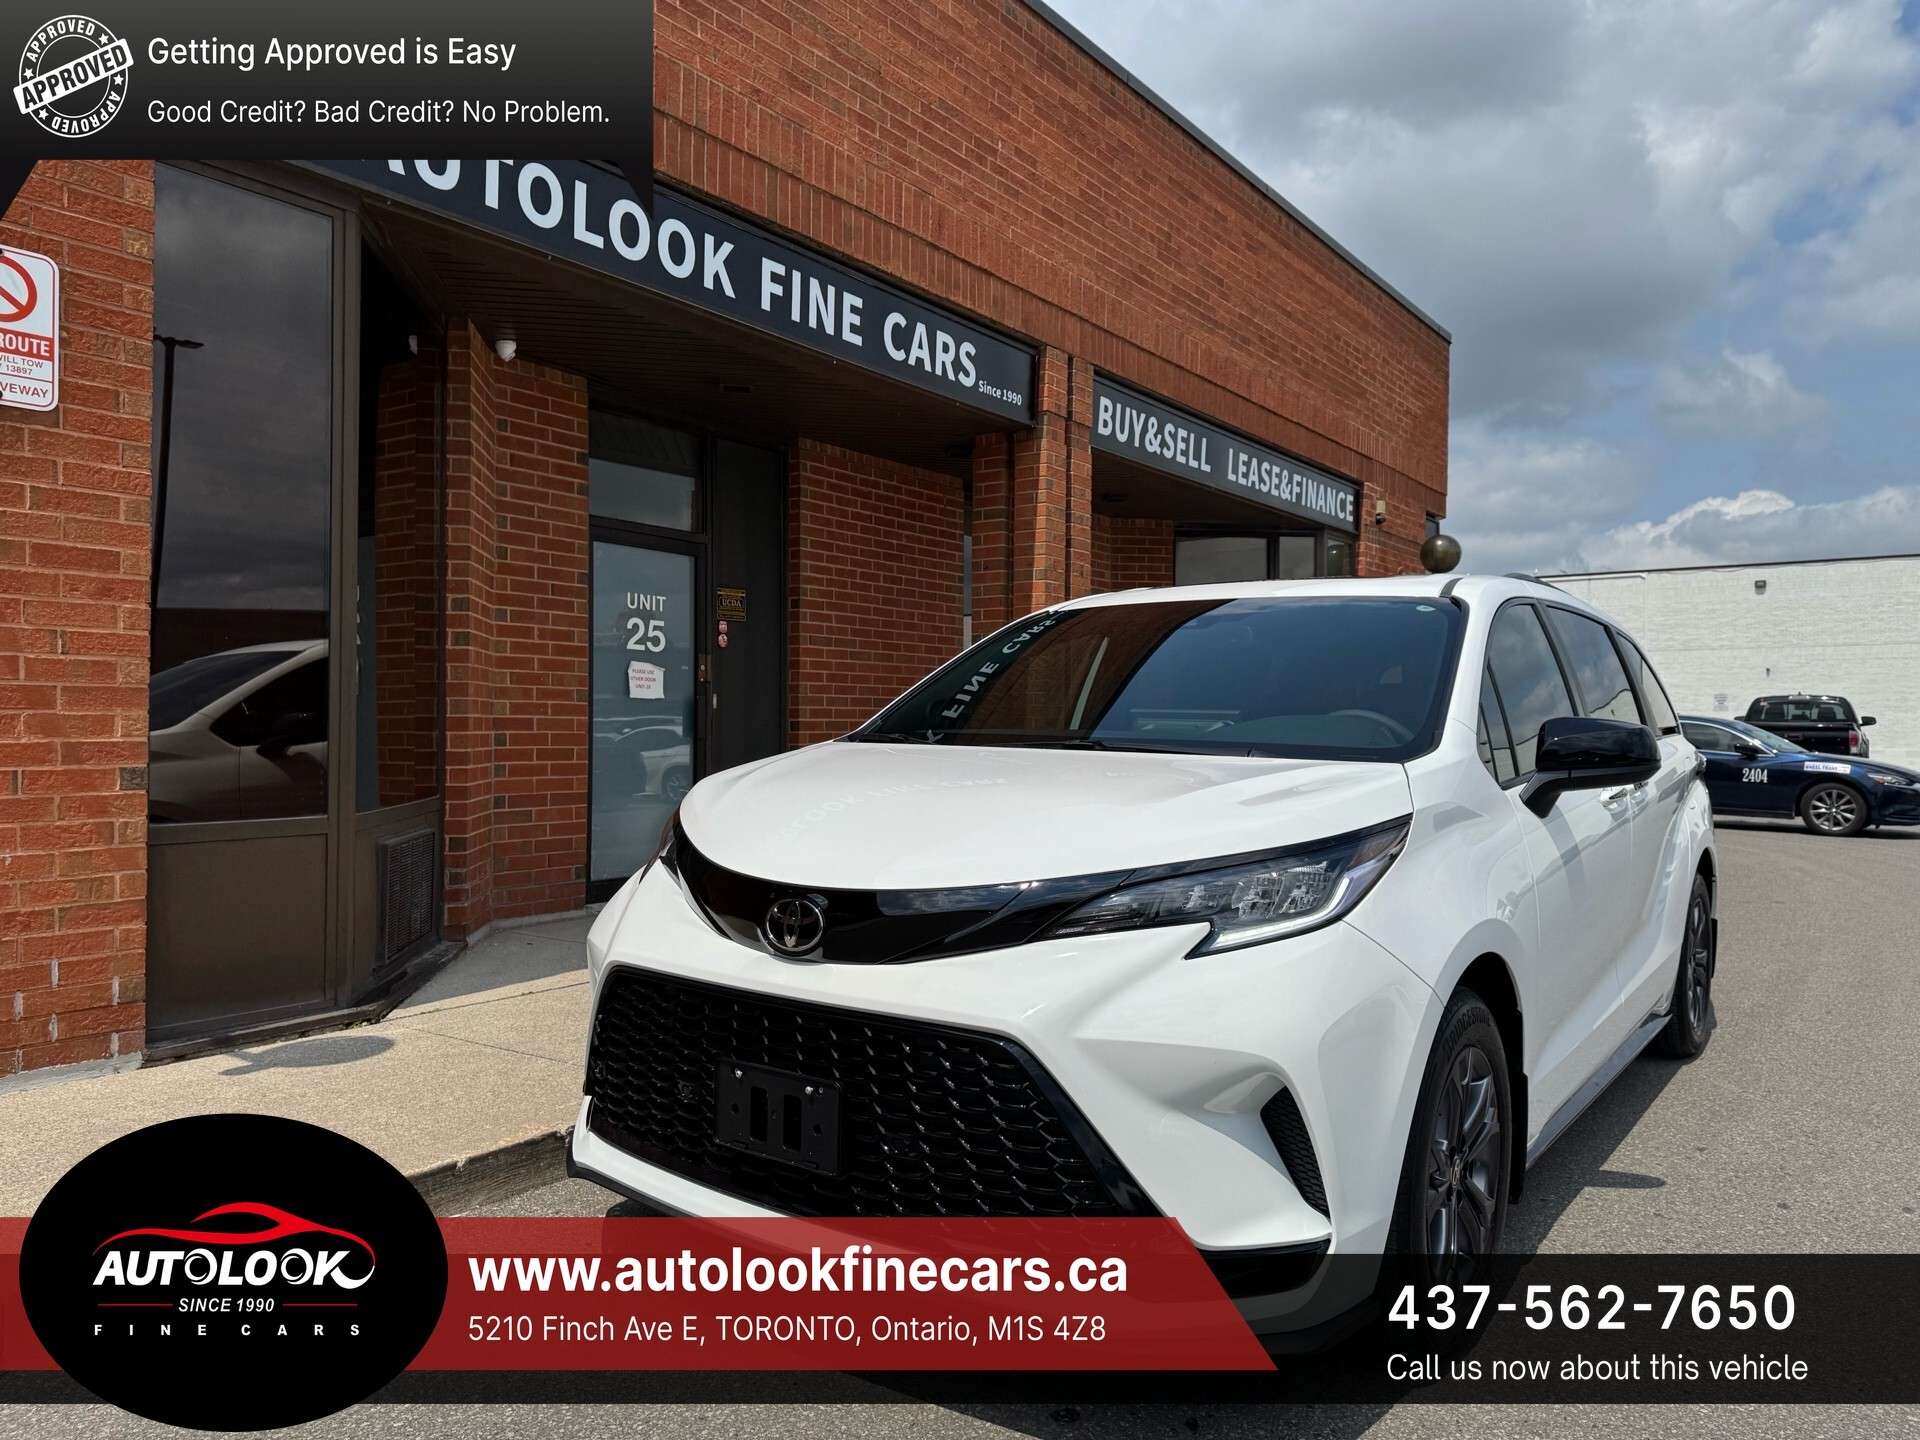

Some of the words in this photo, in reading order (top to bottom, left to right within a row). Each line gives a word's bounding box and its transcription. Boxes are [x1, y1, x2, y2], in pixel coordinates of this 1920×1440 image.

[388, 160, 736, 298] TOLOOK
[761, 257, 864, 345] FINE
[883, 312, 977, 388] CARS
[21, 358, 44, 368] TOW
[978, 380, 1002, 399] Since
[1003, 389, 1022, 406] 1990
[1097, 395, 1211, 473] BUY&SELL
[1227, 447, 1355, 523] LEASE&FINANCE
[627, 591, 667, 612] UNIT
[626, 616, 667, 653] 25
[1742, 767, 1768, 783] 2404
